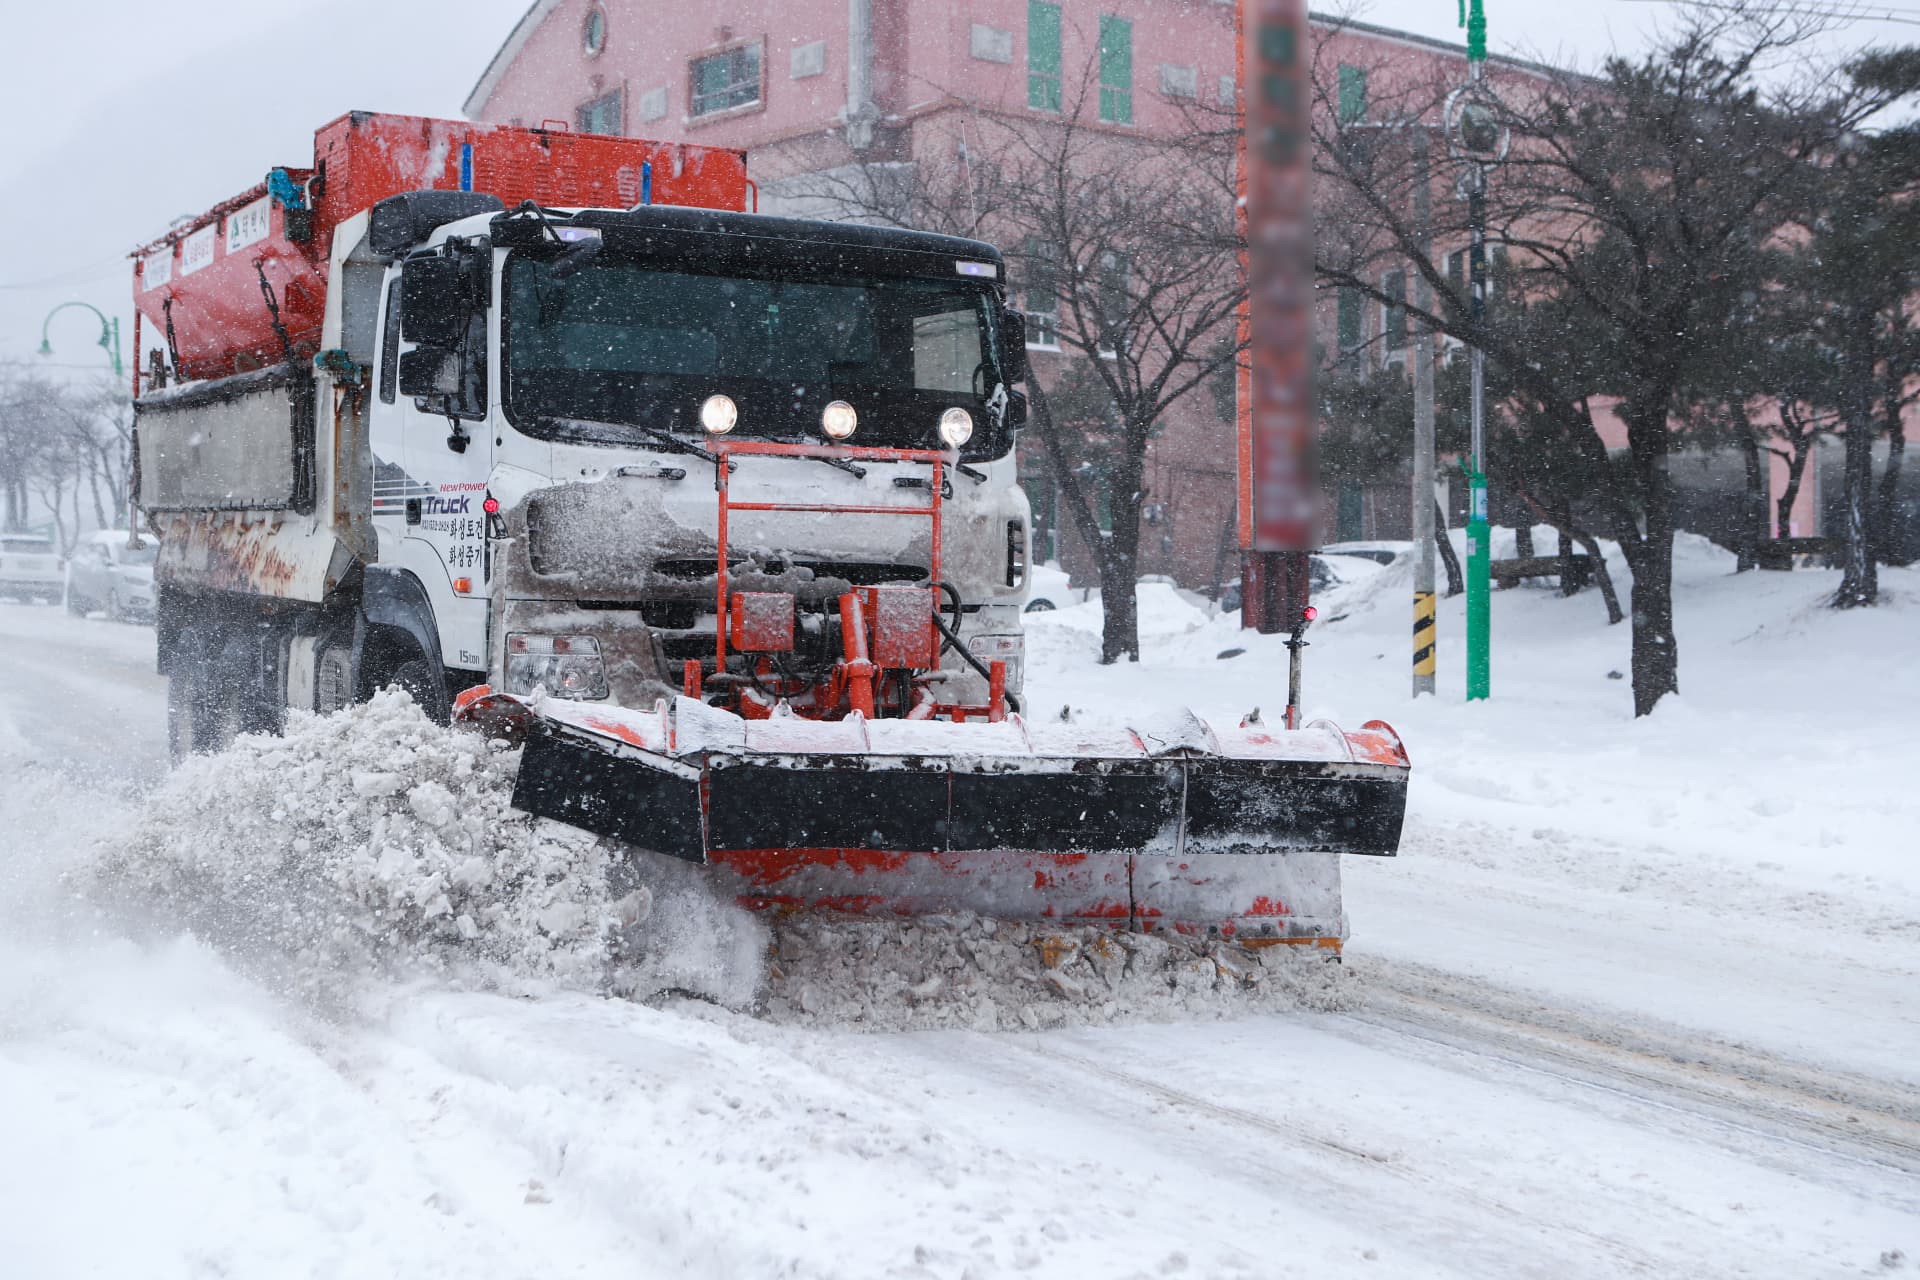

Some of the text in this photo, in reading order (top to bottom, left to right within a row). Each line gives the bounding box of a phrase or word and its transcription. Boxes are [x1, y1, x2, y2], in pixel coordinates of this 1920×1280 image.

[426, 494, 470, 514] Truck
[450, 517, 482, 540] 화성토건
[449, 545, 481, 568] 화성중기
